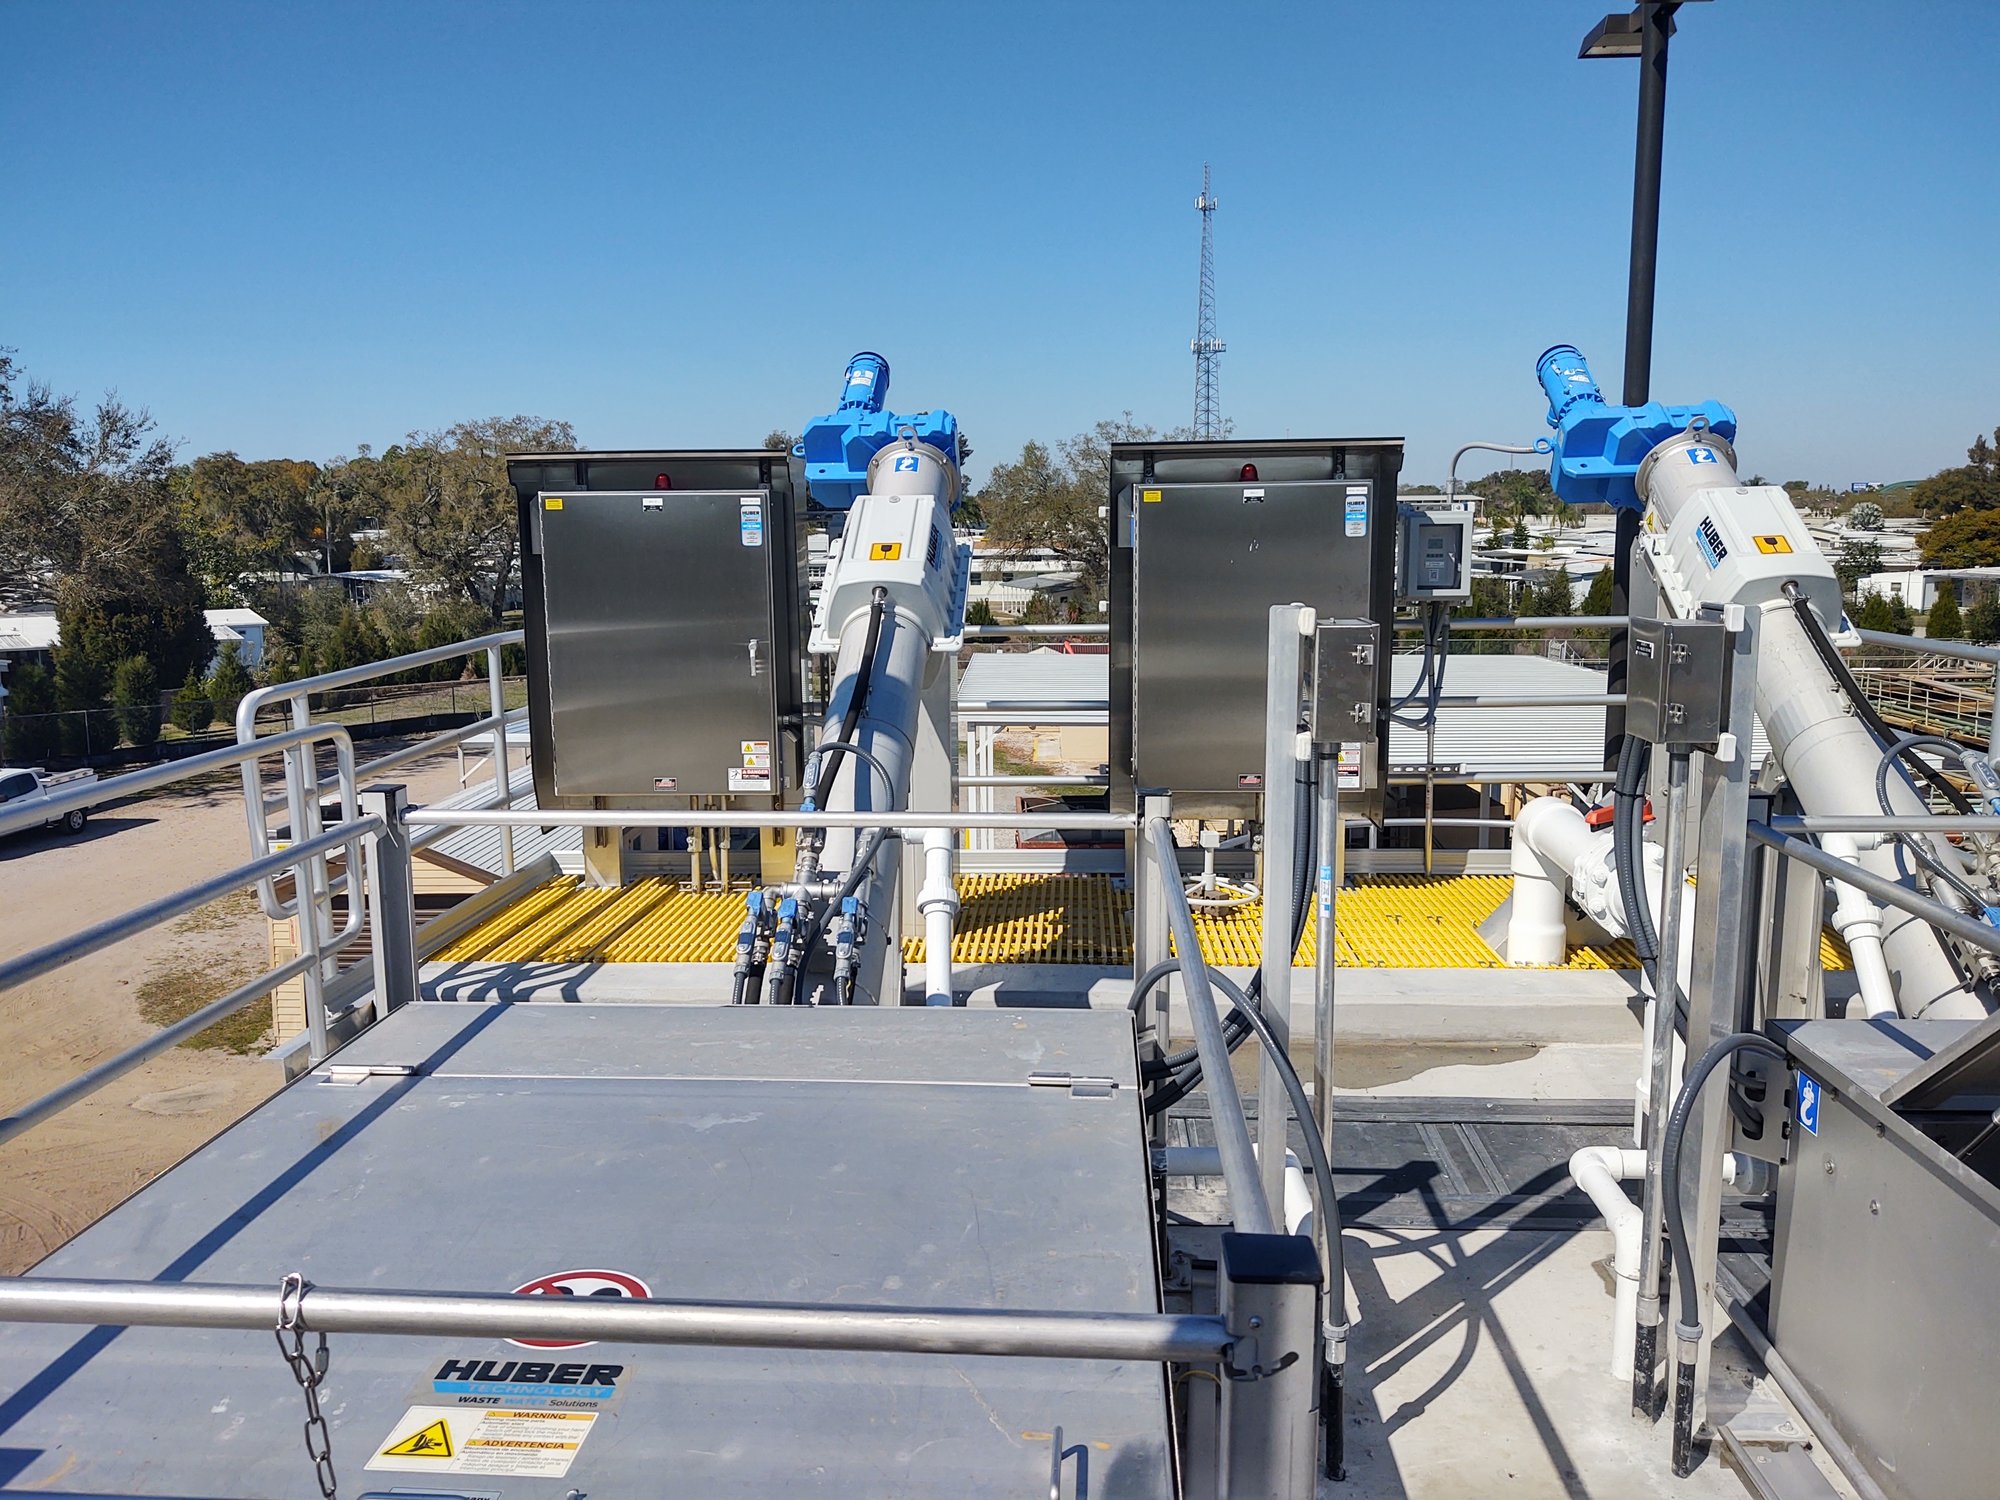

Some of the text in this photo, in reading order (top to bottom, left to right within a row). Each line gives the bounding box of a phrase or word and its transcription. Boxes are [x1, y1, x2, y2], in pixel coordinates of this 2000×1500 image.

[1700, 515, 1728, 562] HUBER
[927, 523, 939, 568] HUBER
[434, 1360, 623, 1385] HUBER
[468, 1384, 607, 1396] TECHNOLOGY
[458, 1396, 598, 1408] WASTE WATER Solutions
[513, 1412, 567, 1420] WARNING
[481, 1440, 564, 1449] ADVERTENCIA
